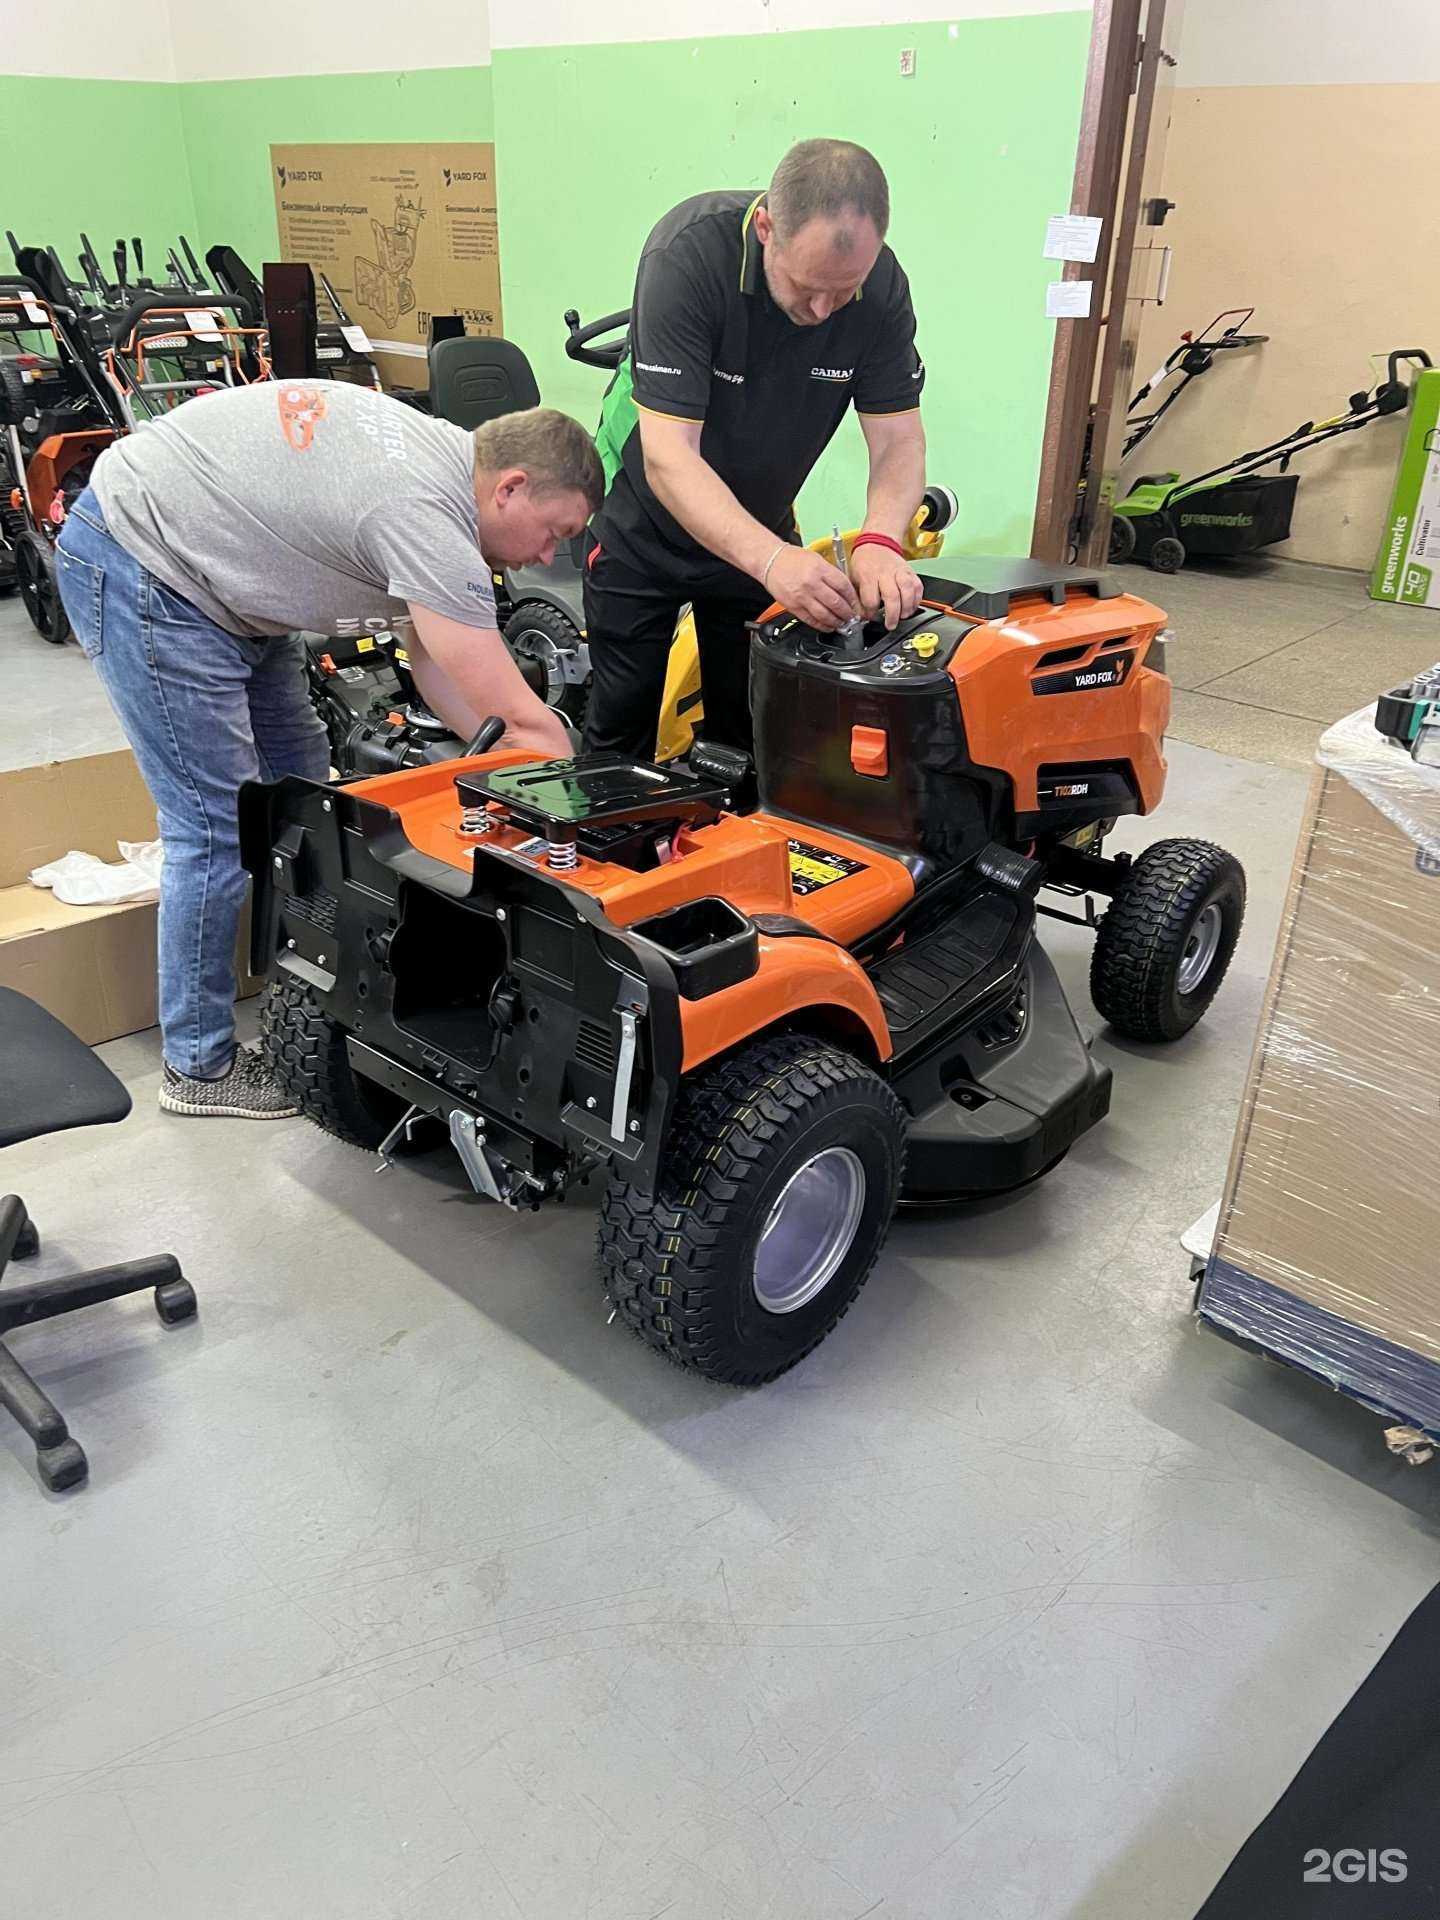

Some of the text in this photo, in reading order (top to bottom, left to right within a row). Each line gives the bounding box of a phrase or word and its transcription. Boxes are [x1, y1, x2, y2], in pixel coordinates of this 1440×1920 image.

[287, 170, 323, 181] YARD FOX
[453, 172, 487, 181] YARD FOX
[1180, 512, 1255, 528] greenworks
[1416, 519, 1431, 556] Cultivator
[1382, 516, 1409, 594] greenworks
[1075, 671, 1113, 687] YARD FOX
